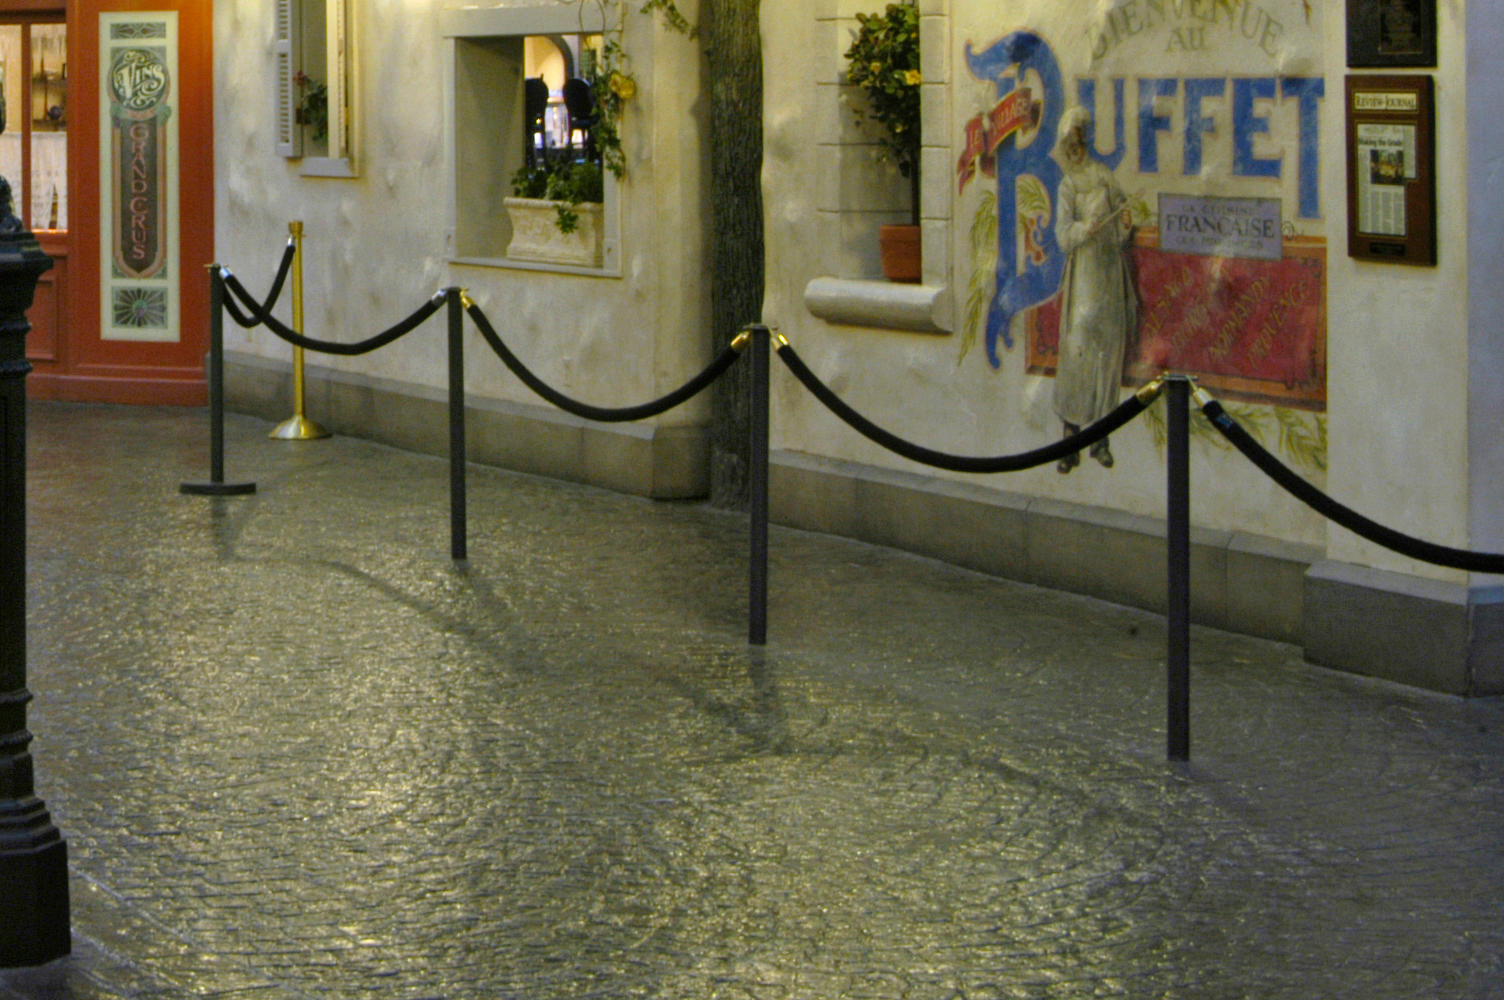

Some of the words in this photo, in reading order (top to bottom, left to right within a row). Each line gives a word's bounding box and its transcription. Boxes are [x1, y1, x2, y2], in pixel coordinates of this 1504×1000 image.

[1166, 25, 1207, 53] AU
[115, 60, 165, 99] VINS
[129, 123, 149, 194] GRAND
[129, 196, 149, 260] CRUS
[964, 29, 1326, 369] BUFFET
